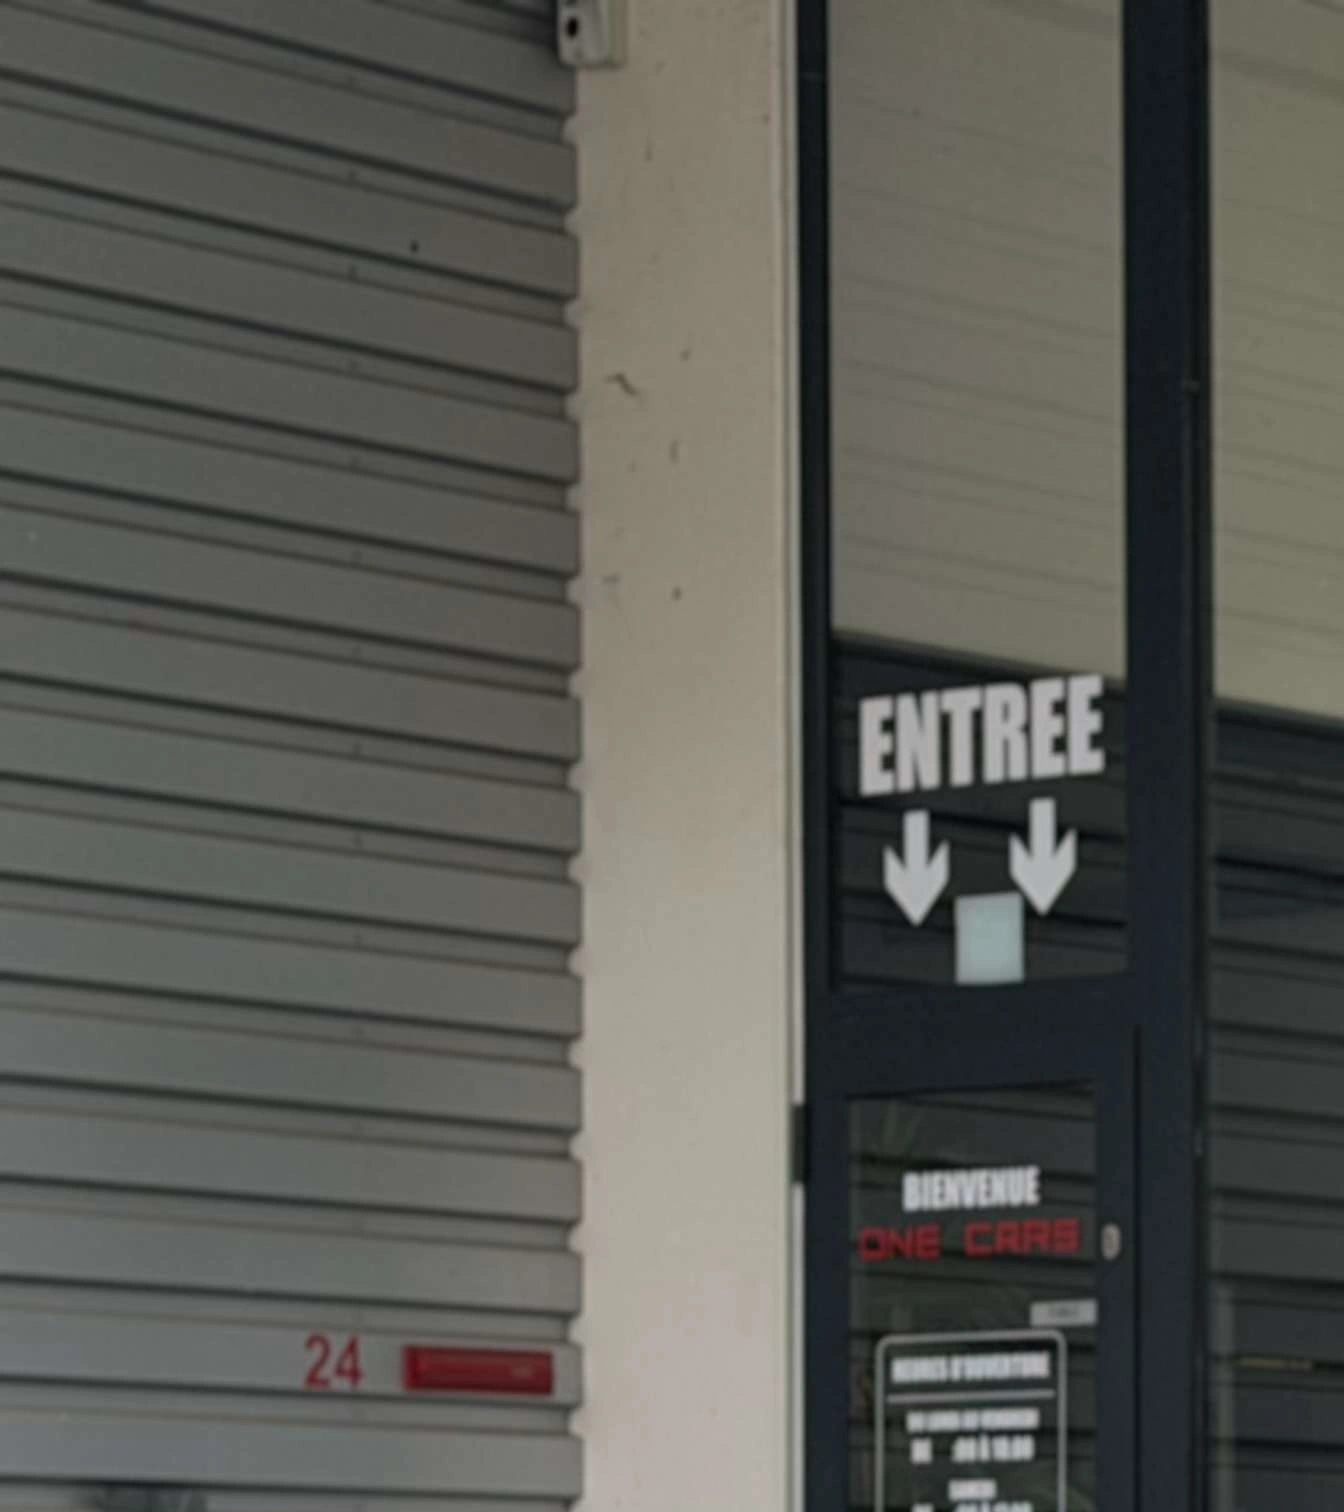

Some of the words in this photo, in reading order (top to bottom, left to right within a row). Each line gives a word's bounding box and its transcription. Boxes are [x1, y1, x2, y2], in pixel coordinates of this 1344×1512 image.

[859, 674, 1104, 797] ENTREE
[902, 1165, 1041, 1213] BIENVENUE
[858, 1223, 942, 1262] ONE
[964, 1217, 1082, 1258] CARS
[304, 1332, 364, 1390] 24
